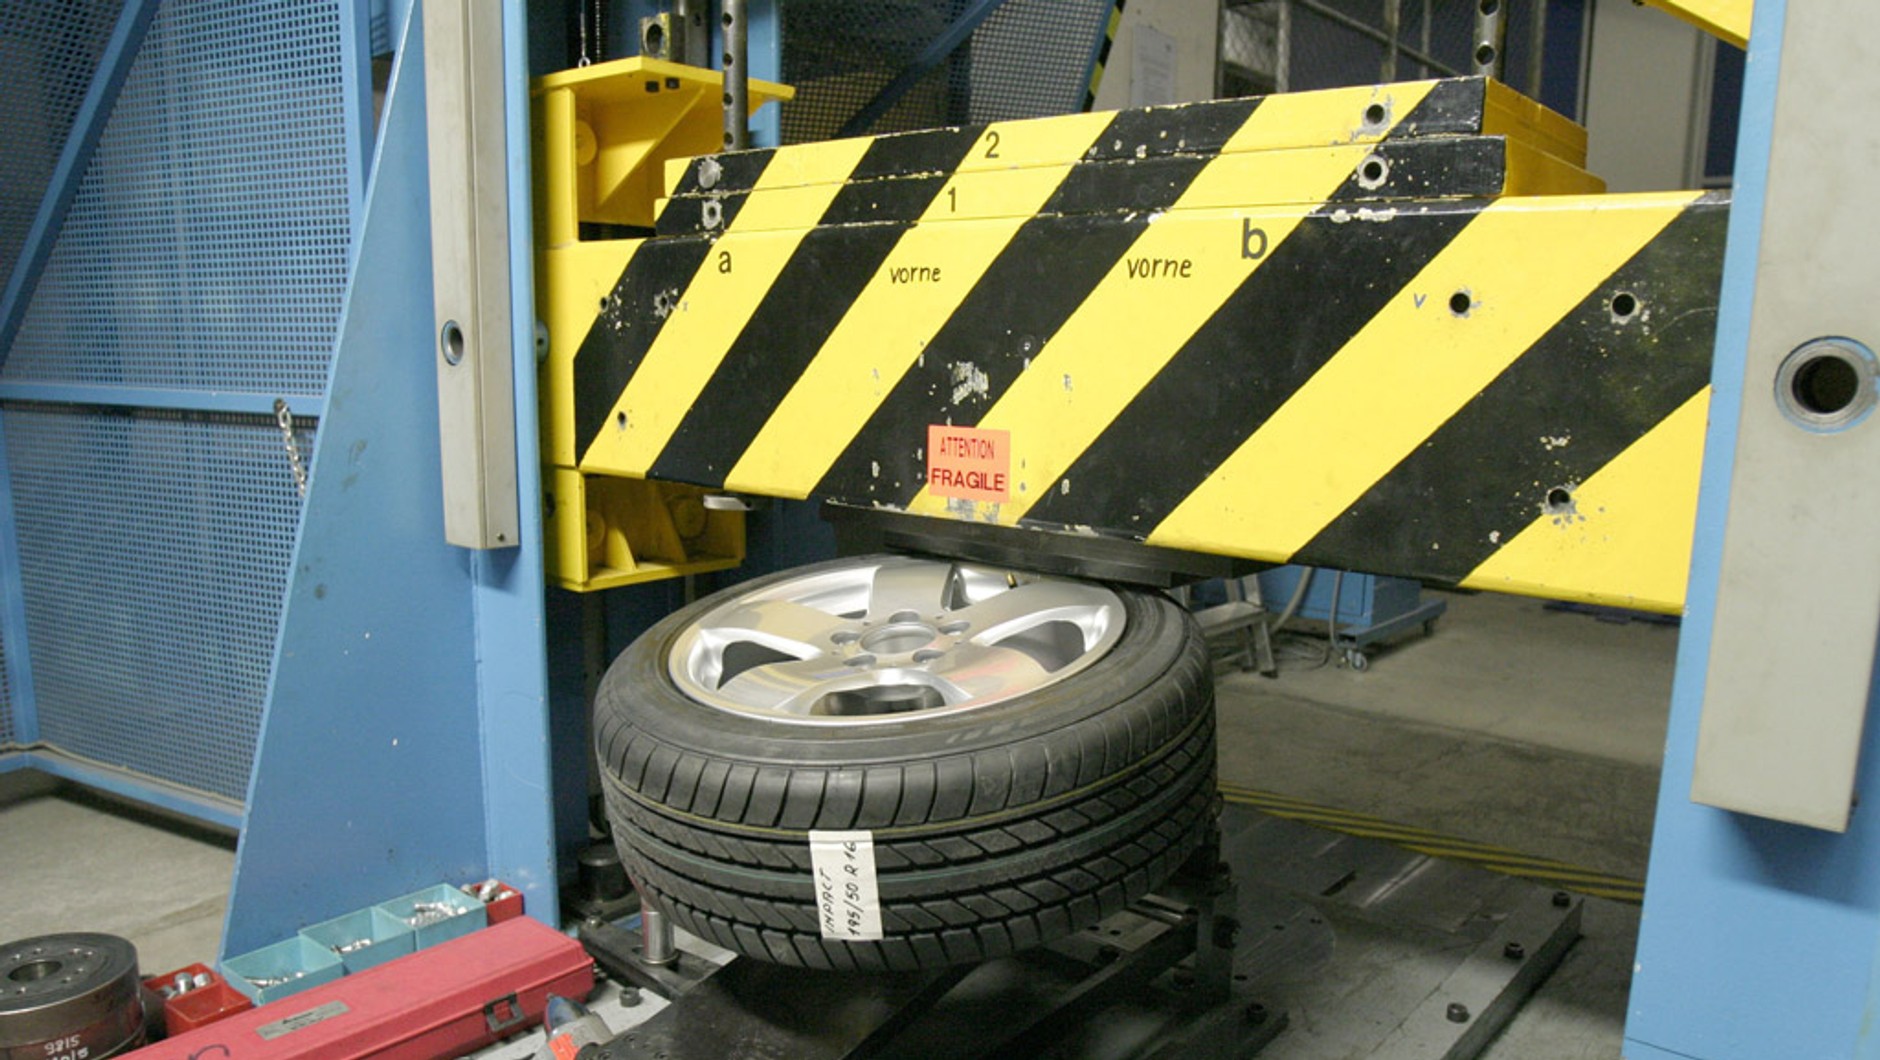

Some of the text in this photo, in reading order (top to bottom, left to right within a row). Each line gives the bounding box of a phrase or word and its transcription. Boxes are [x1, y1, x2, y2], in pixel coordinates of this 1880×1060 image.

[984, 130, 1000, 158] 2
[947, 186, 957, 213] 1
[1241, 217, 1269, 260] b
[718, 250, 732, 274] a
[1126, 257, 1193, 280] vorne
[889, 266, 942, 285] vorne
[940, 436, 995, 460] ATTENTION
[930, 467, 1006, 492] FRAGILE
[818, 867, 835, 934] IMPACT
[842, 840, 865, 936] 195/50 R 16
